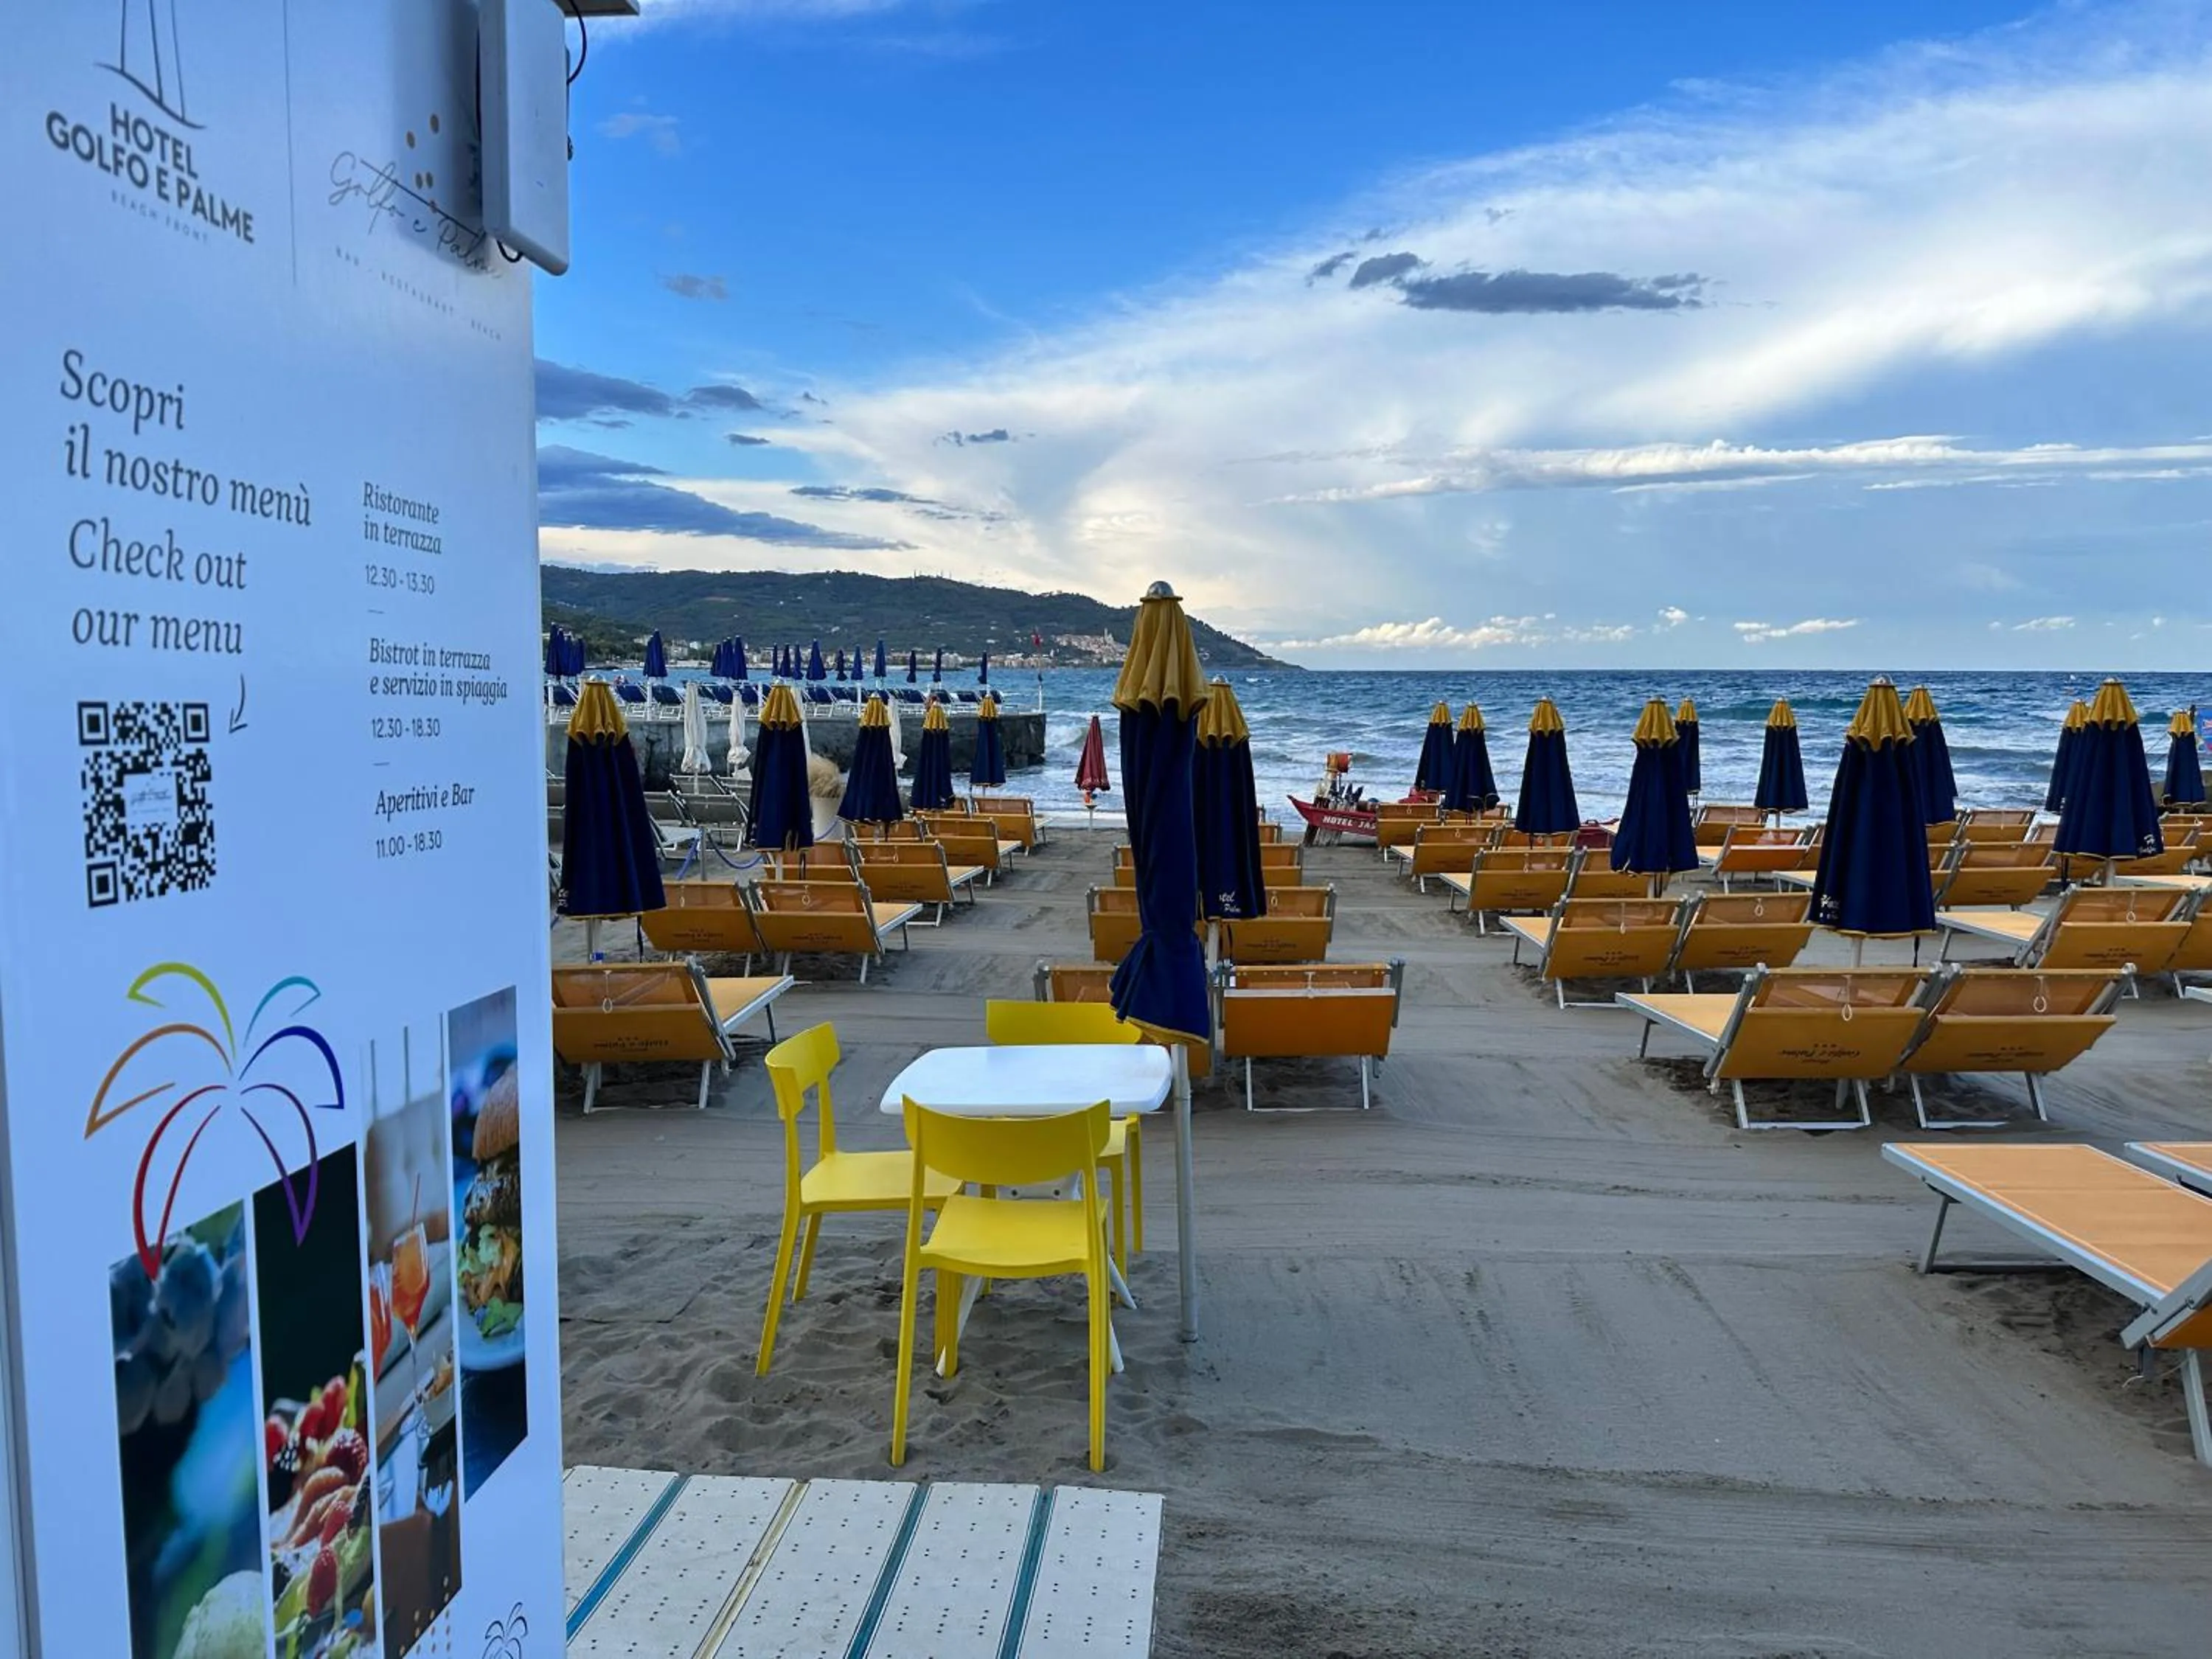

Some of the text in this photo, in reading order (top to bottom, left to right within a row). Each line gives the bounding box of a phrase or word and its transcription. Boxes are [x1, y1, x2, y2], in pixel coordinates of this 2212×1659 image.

[111, 102, 198, 179] HOTEL
[46, 111, 255, 244] GOLFO E PALME
[60, 349, 184, 435] Scopri
[65, 423, 311, 526] il nostro menù
[363, 481, 439, 524] Ristorante
[69, 517, 247, 589] Check out
[364, 514, 442, 554] in terrazza
[72, 608, 243, 655] our menu
[369, 638, 491, 670] Bistrot in terrazza
[370, 672, 507, 706] e servizio in spiaggia
[375, 782, 476, 823] Aperitivi e Bar
[1322, 815, 1377, 830] HOTEL JAS
